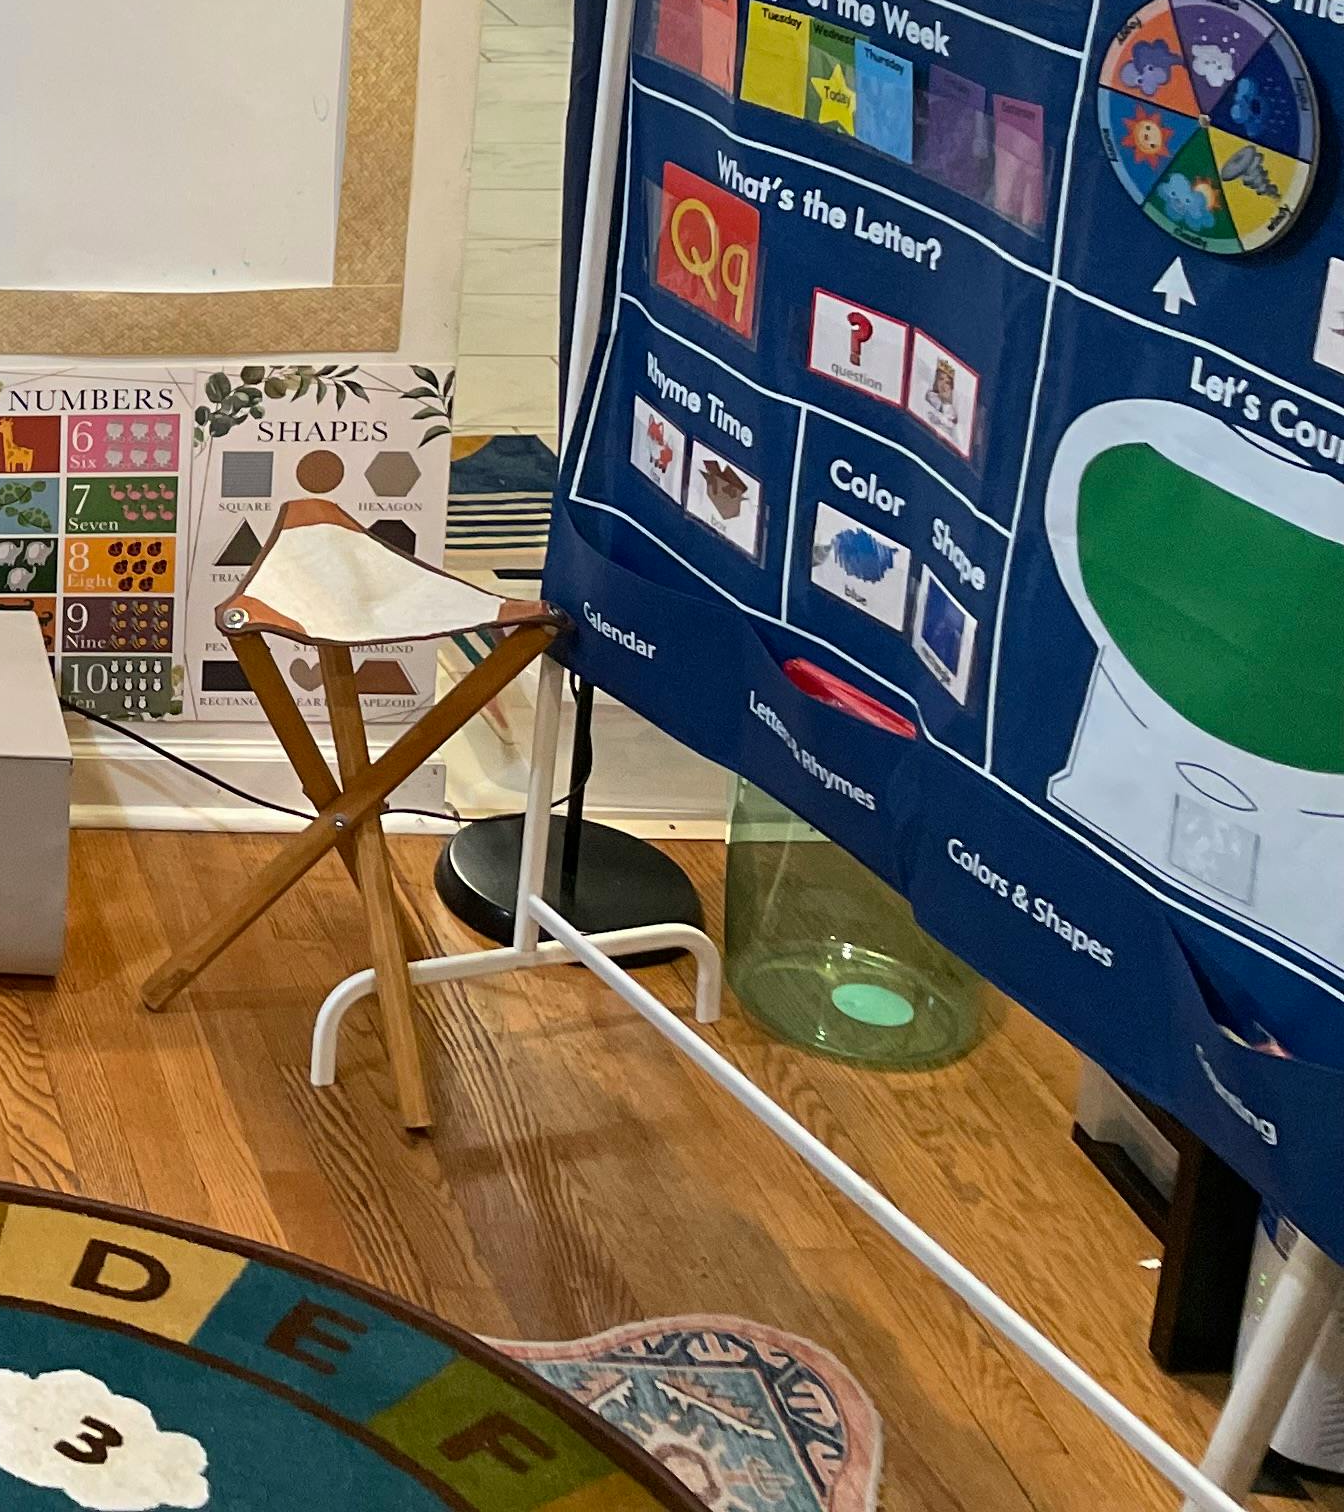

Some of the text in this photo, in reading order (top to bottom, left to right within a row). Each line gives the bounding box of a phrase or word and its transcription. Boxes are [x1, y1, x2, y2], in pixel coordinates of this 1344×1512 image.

[762, 6, 802, 29] Tuesday
[883, 1, 949, 57] Week
[864, 46, 908, 74] Thursday
[824, 83, 851, 109] Today
[717, 150, 943, 271] What's the Letter?
[671, 197, 749, 322] Qq
[8, 389, 174, 411] NUMBERS
[647, 351, 753, 449] Rhyme Time
[831, 362, 881, 392] question
[1191, 356, 1260, 421] Let's
[257, 420, 389, 443] SHAPES
[358, 502, 423, 512] HEXAGON
[829, 459, 906, 517] Color
[68, 517, 119, 532] Seven
[932, 518, 987, 591] Shape
[844, 585, 868, 607] blue
[65, 635, 107, 649] Nine
[583, 601, 657, 660] Calendar
[69, 663, 109, 695] 10
[947, 838, 1114, 968] Colors & Shapes
[69, 1238, 175, 1305] D
[265, 1296, 369, 1375] E
[51, 1414, 126, 1465] 3
[437, 1410, 558, 1477] F
